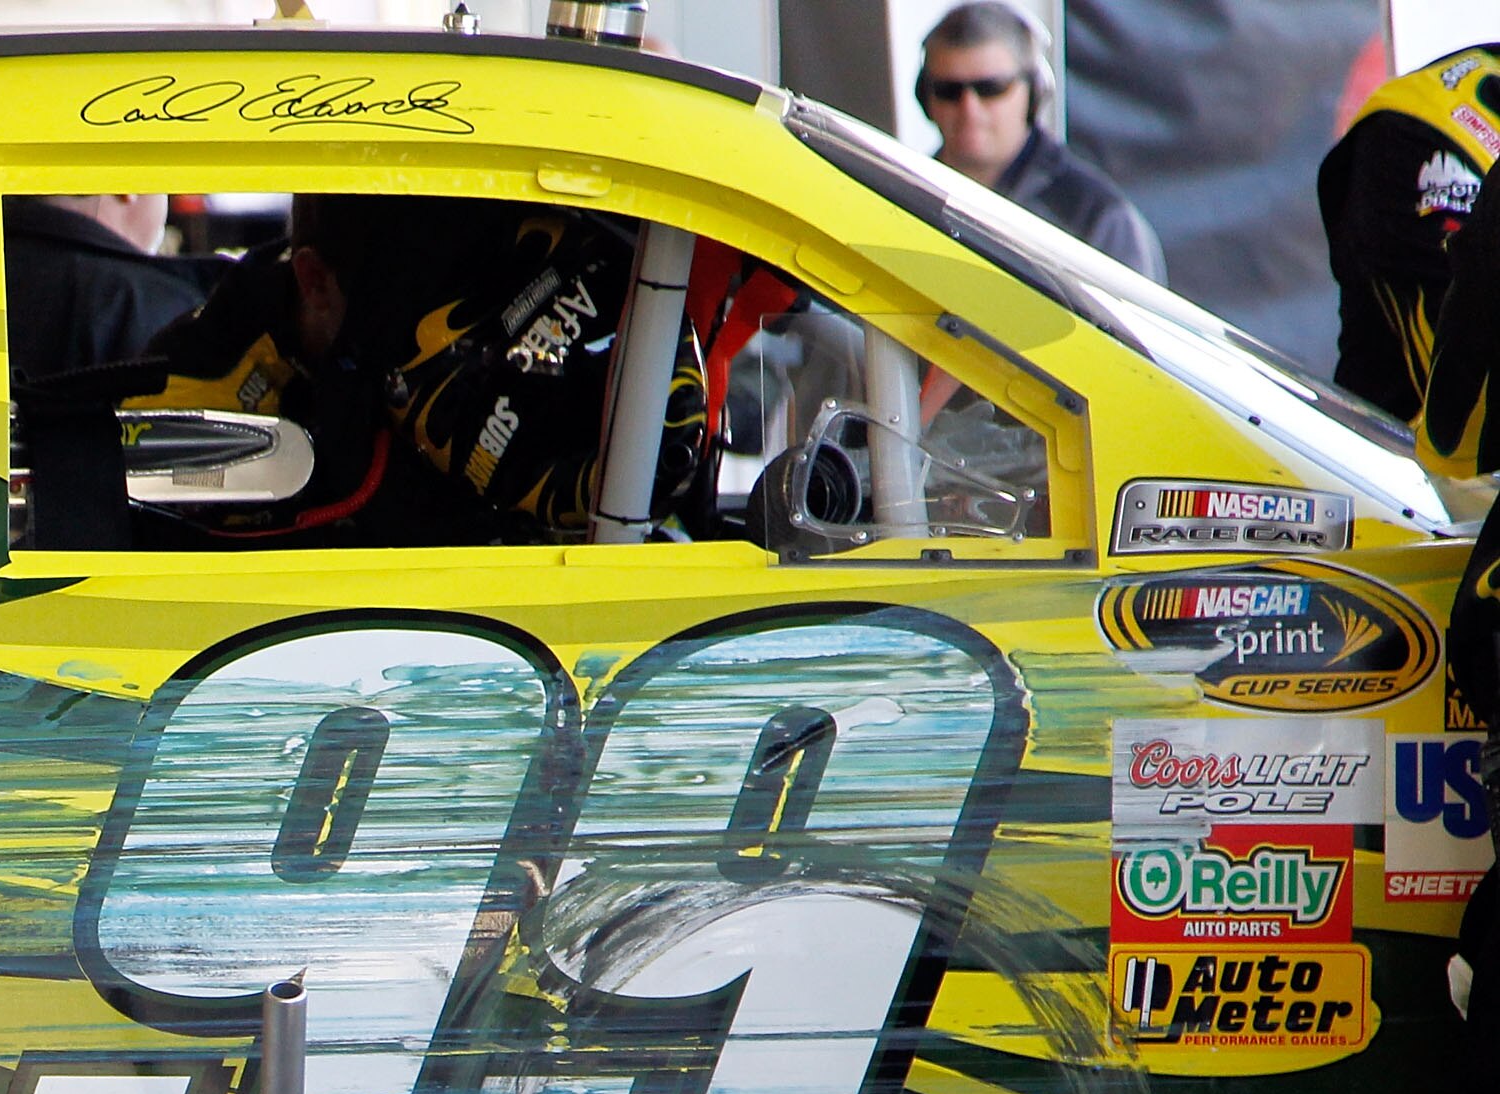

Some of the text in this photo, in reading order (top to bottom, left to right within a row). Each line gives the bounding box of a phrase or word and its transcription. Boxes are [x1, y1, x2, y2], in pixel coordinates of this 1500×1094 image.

[1207, 491, 1308, 523] NASCAR
[1130, 525, 1328, 547] RACE CAR
[1194, 586, 1304, 618] NASCAR
[1215, 620, 1326, 664] Sprint
[1229, 676, 1399, 697] CUP SERIES
[1129, 739, 1371, 789] Coors LIGHT
[1160, 791, 1337, 815] POLE
[1127, 847, 1332, 914] O'Reilly
[1183, 921, 1282, 937] AUTO PARTS
[1181, 955, 1324, 994] Auto
[1172, 995, 1354, 1033] Meter
[1184, 1034, 1348, 1046] PERFORMANCE GAUGES
